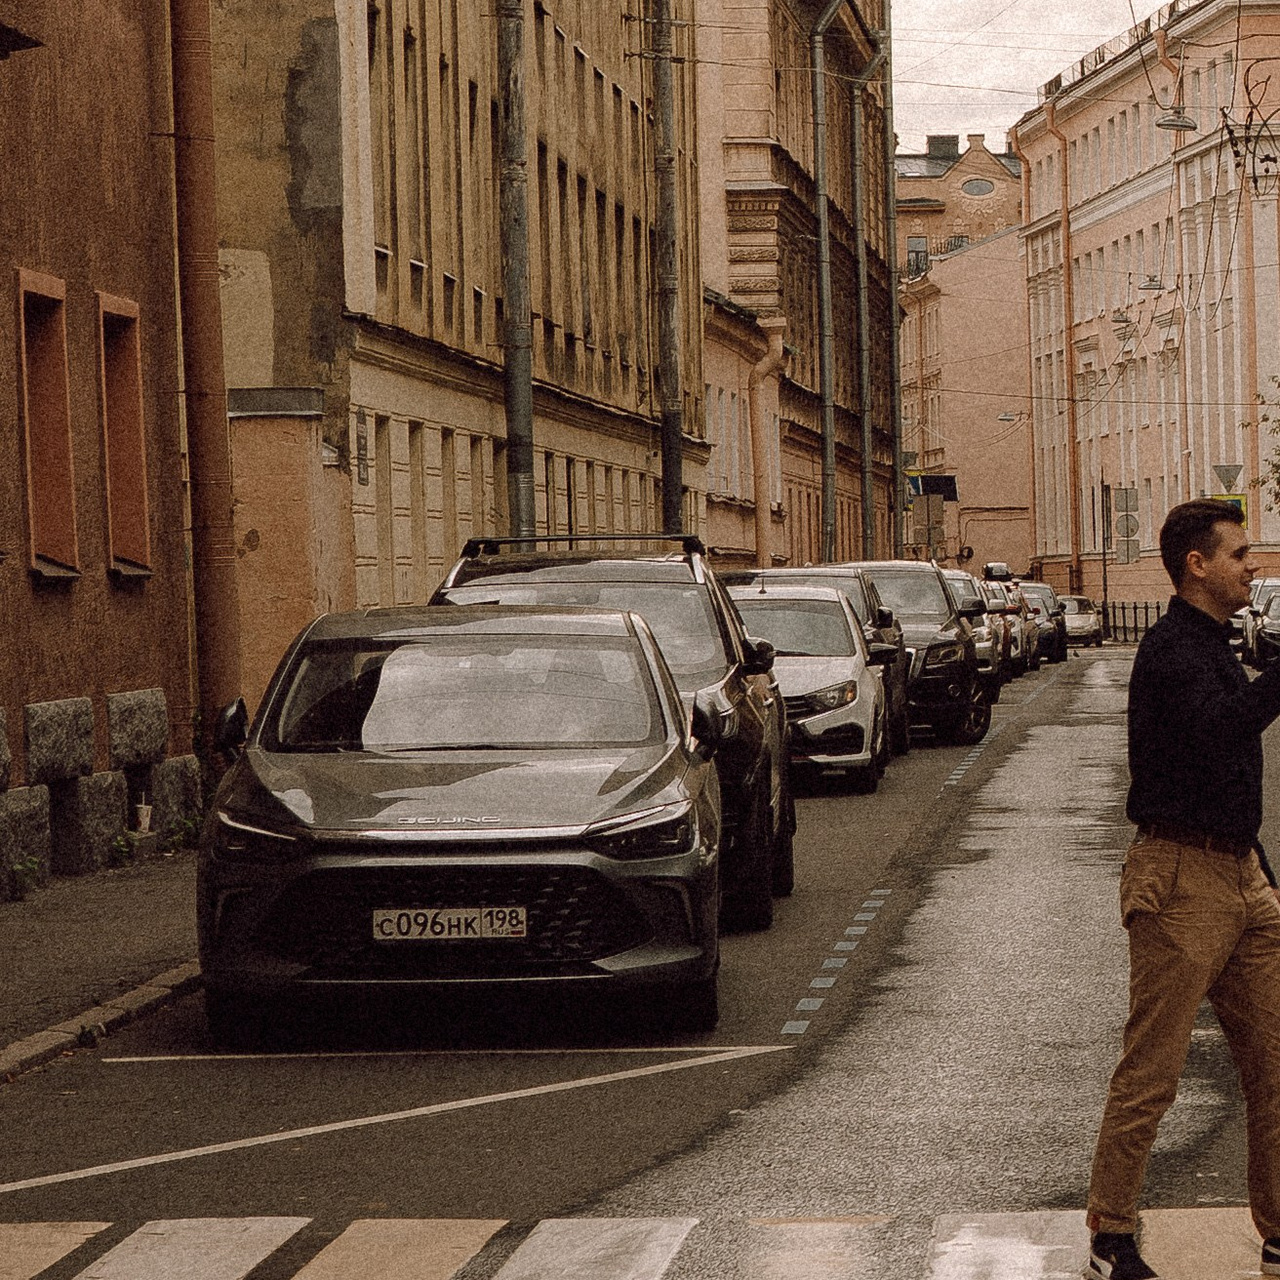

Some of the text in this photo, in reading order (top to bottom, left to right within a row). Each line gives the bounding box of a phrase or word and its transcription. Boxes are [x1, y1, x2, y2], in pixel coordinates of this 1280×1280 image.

[397, 816, 501, 825] BEIJING
[379, 911, 478, 937] С096НК
[491, 928, 510, 936] RUS
